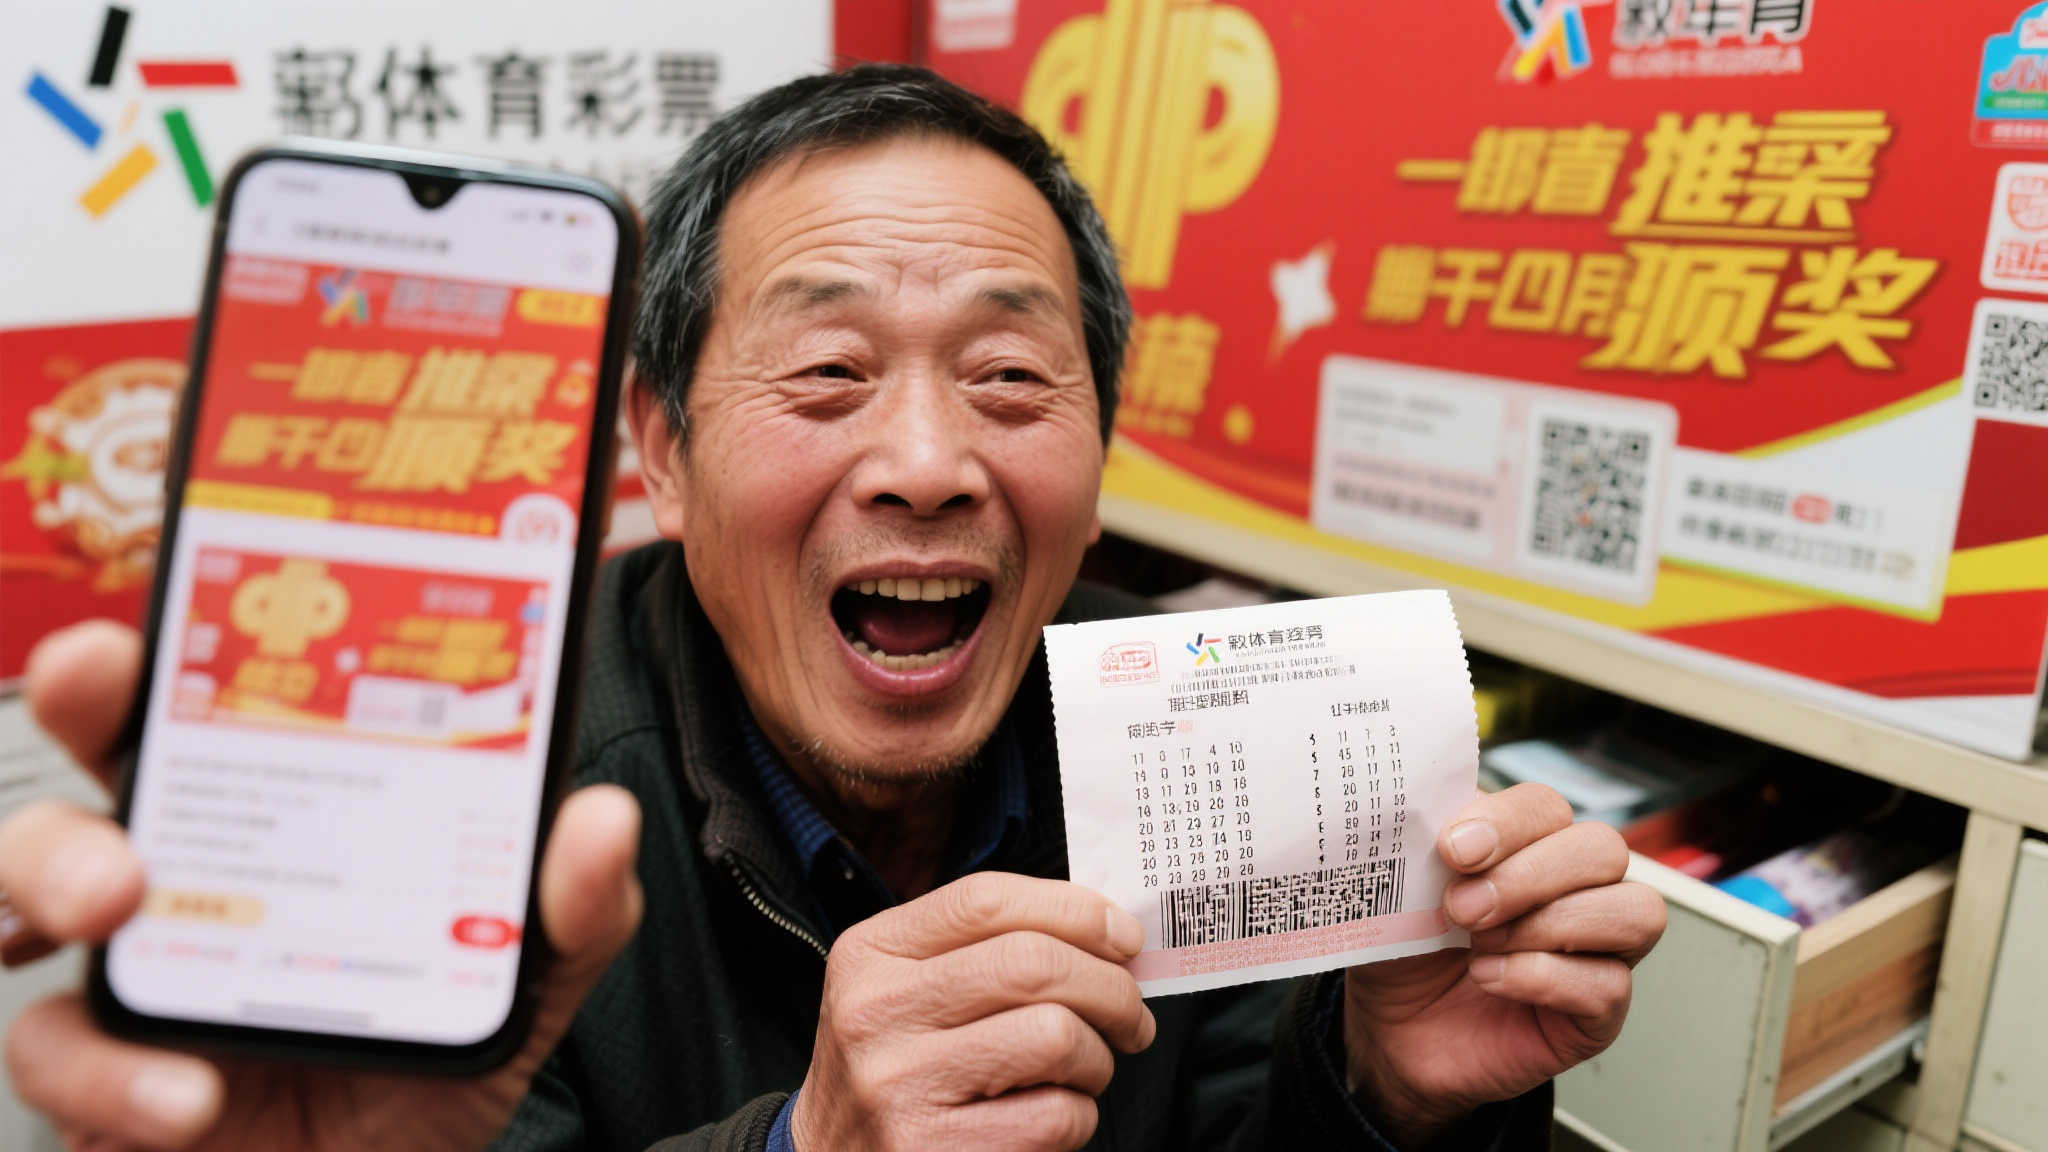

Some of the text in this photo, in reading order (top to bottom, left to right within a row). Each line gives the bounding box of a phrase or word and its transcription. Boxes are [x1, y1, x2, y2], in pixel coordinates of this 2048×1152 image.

[1209, 744, 1217, 756] 4
[1344, 782, 1356, 795] 20
[1345, 800, 1358, 812] 20
[1239, 846, 1253, 859] 20
[1240, 863, 1253, 876] 20
